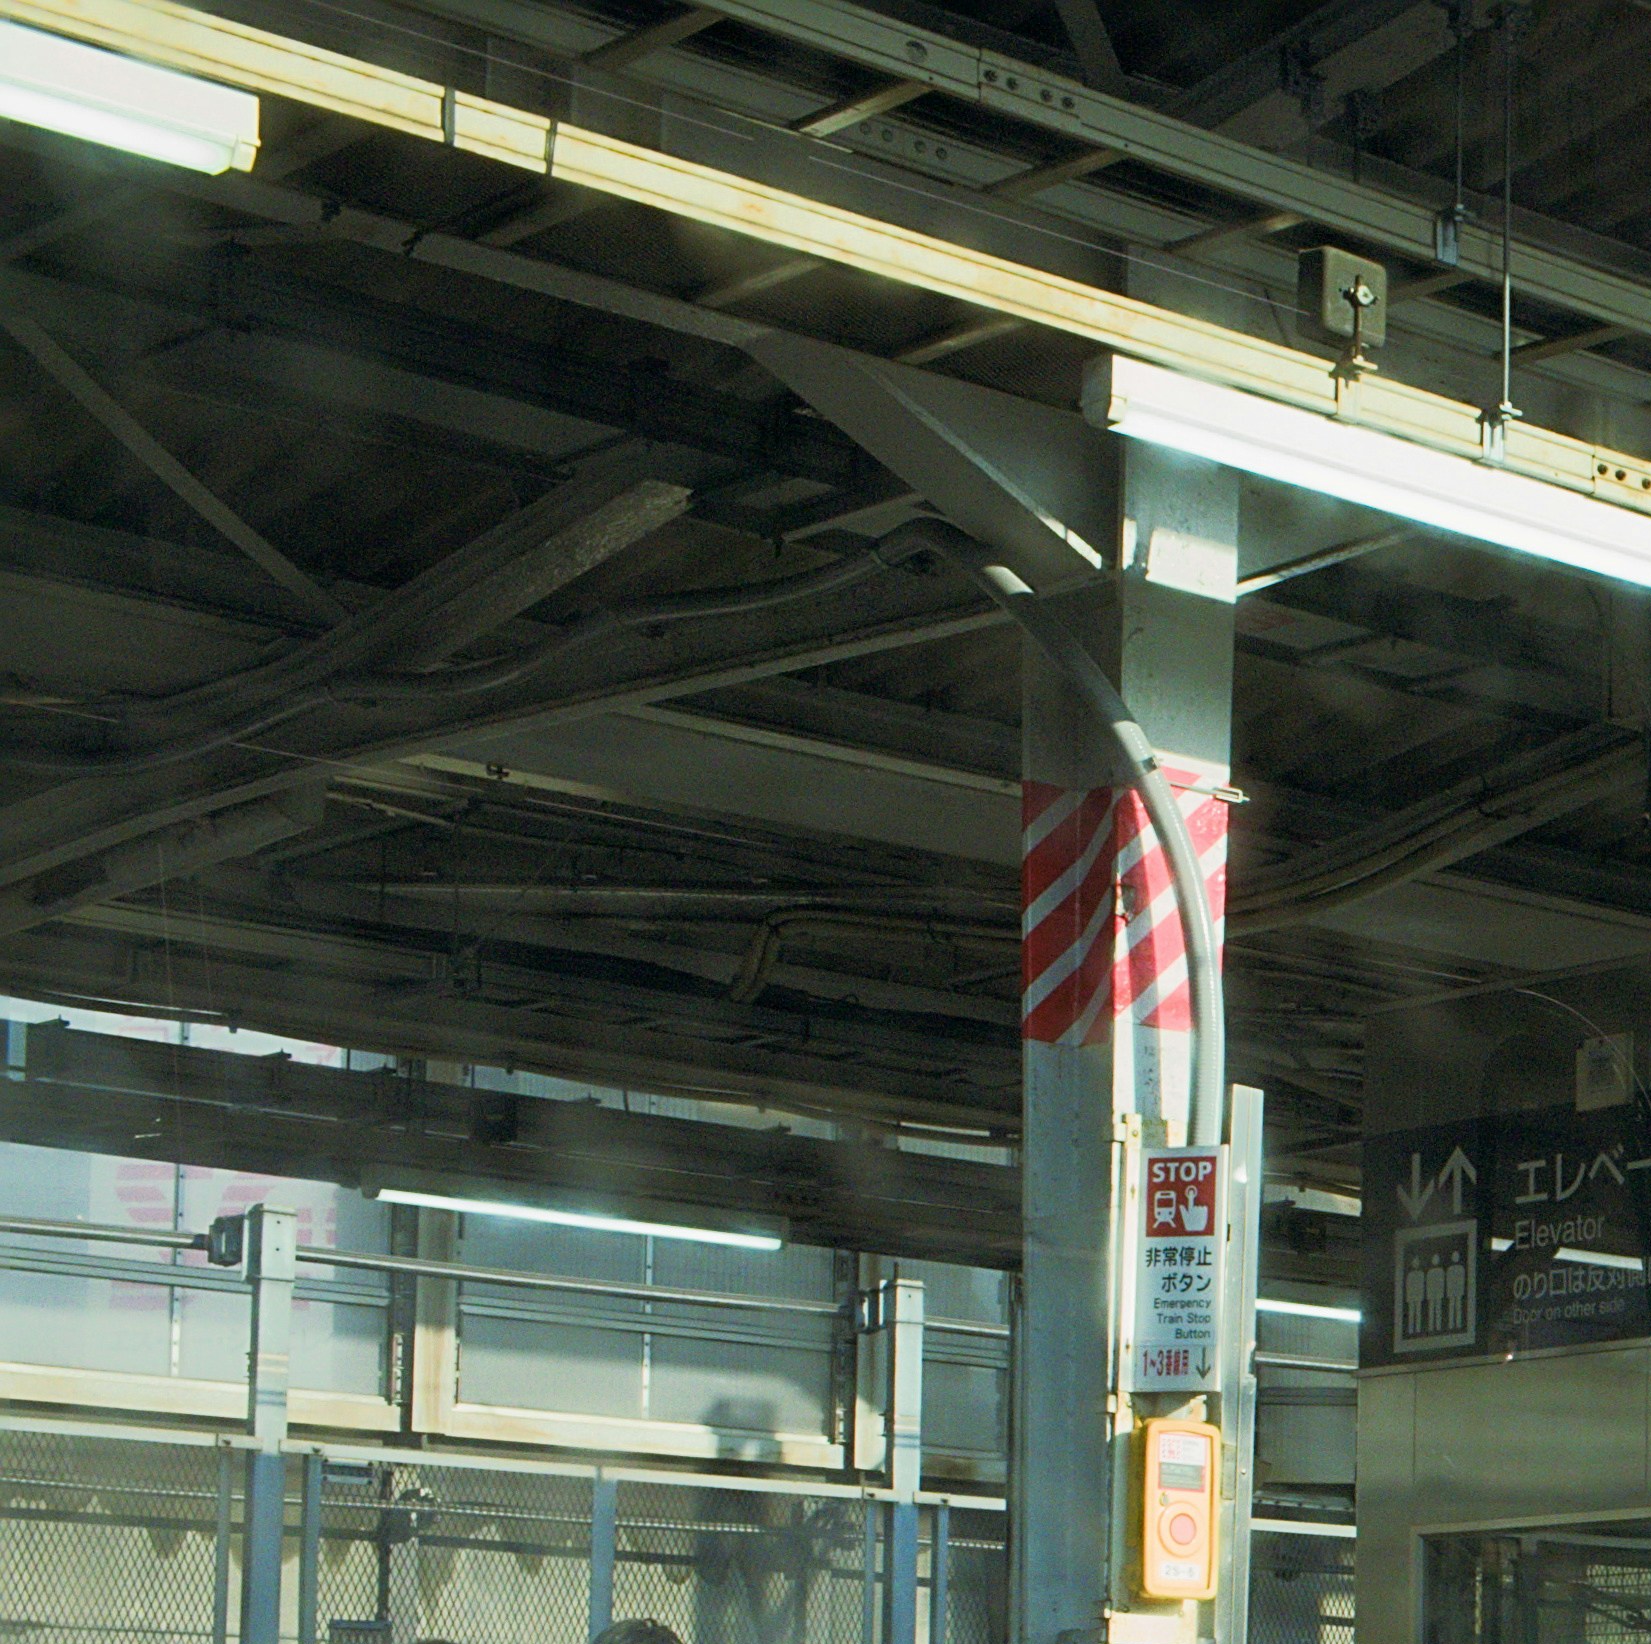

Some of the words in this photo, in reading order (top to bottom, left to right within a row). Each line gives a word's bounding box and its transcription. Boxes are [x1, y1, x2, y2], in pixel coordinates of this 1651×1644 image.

[1152, 1161, 1212, 1183] STOP
[1515, 1214, 1605, 1250] Elevator
[1146, 1246, 1212, 1267] 非常停止
[1162, 1272, 1211, 1293] ボタン
[1153, 1298, 1211, 1311] Emergency
[1565, 1302, 1595, 1317] other
[1157, 1312, 1183, 1324] Train
[1187, 1312, 1212, 1325] Stop
[1175, 1328, 1211, 1339] Button
